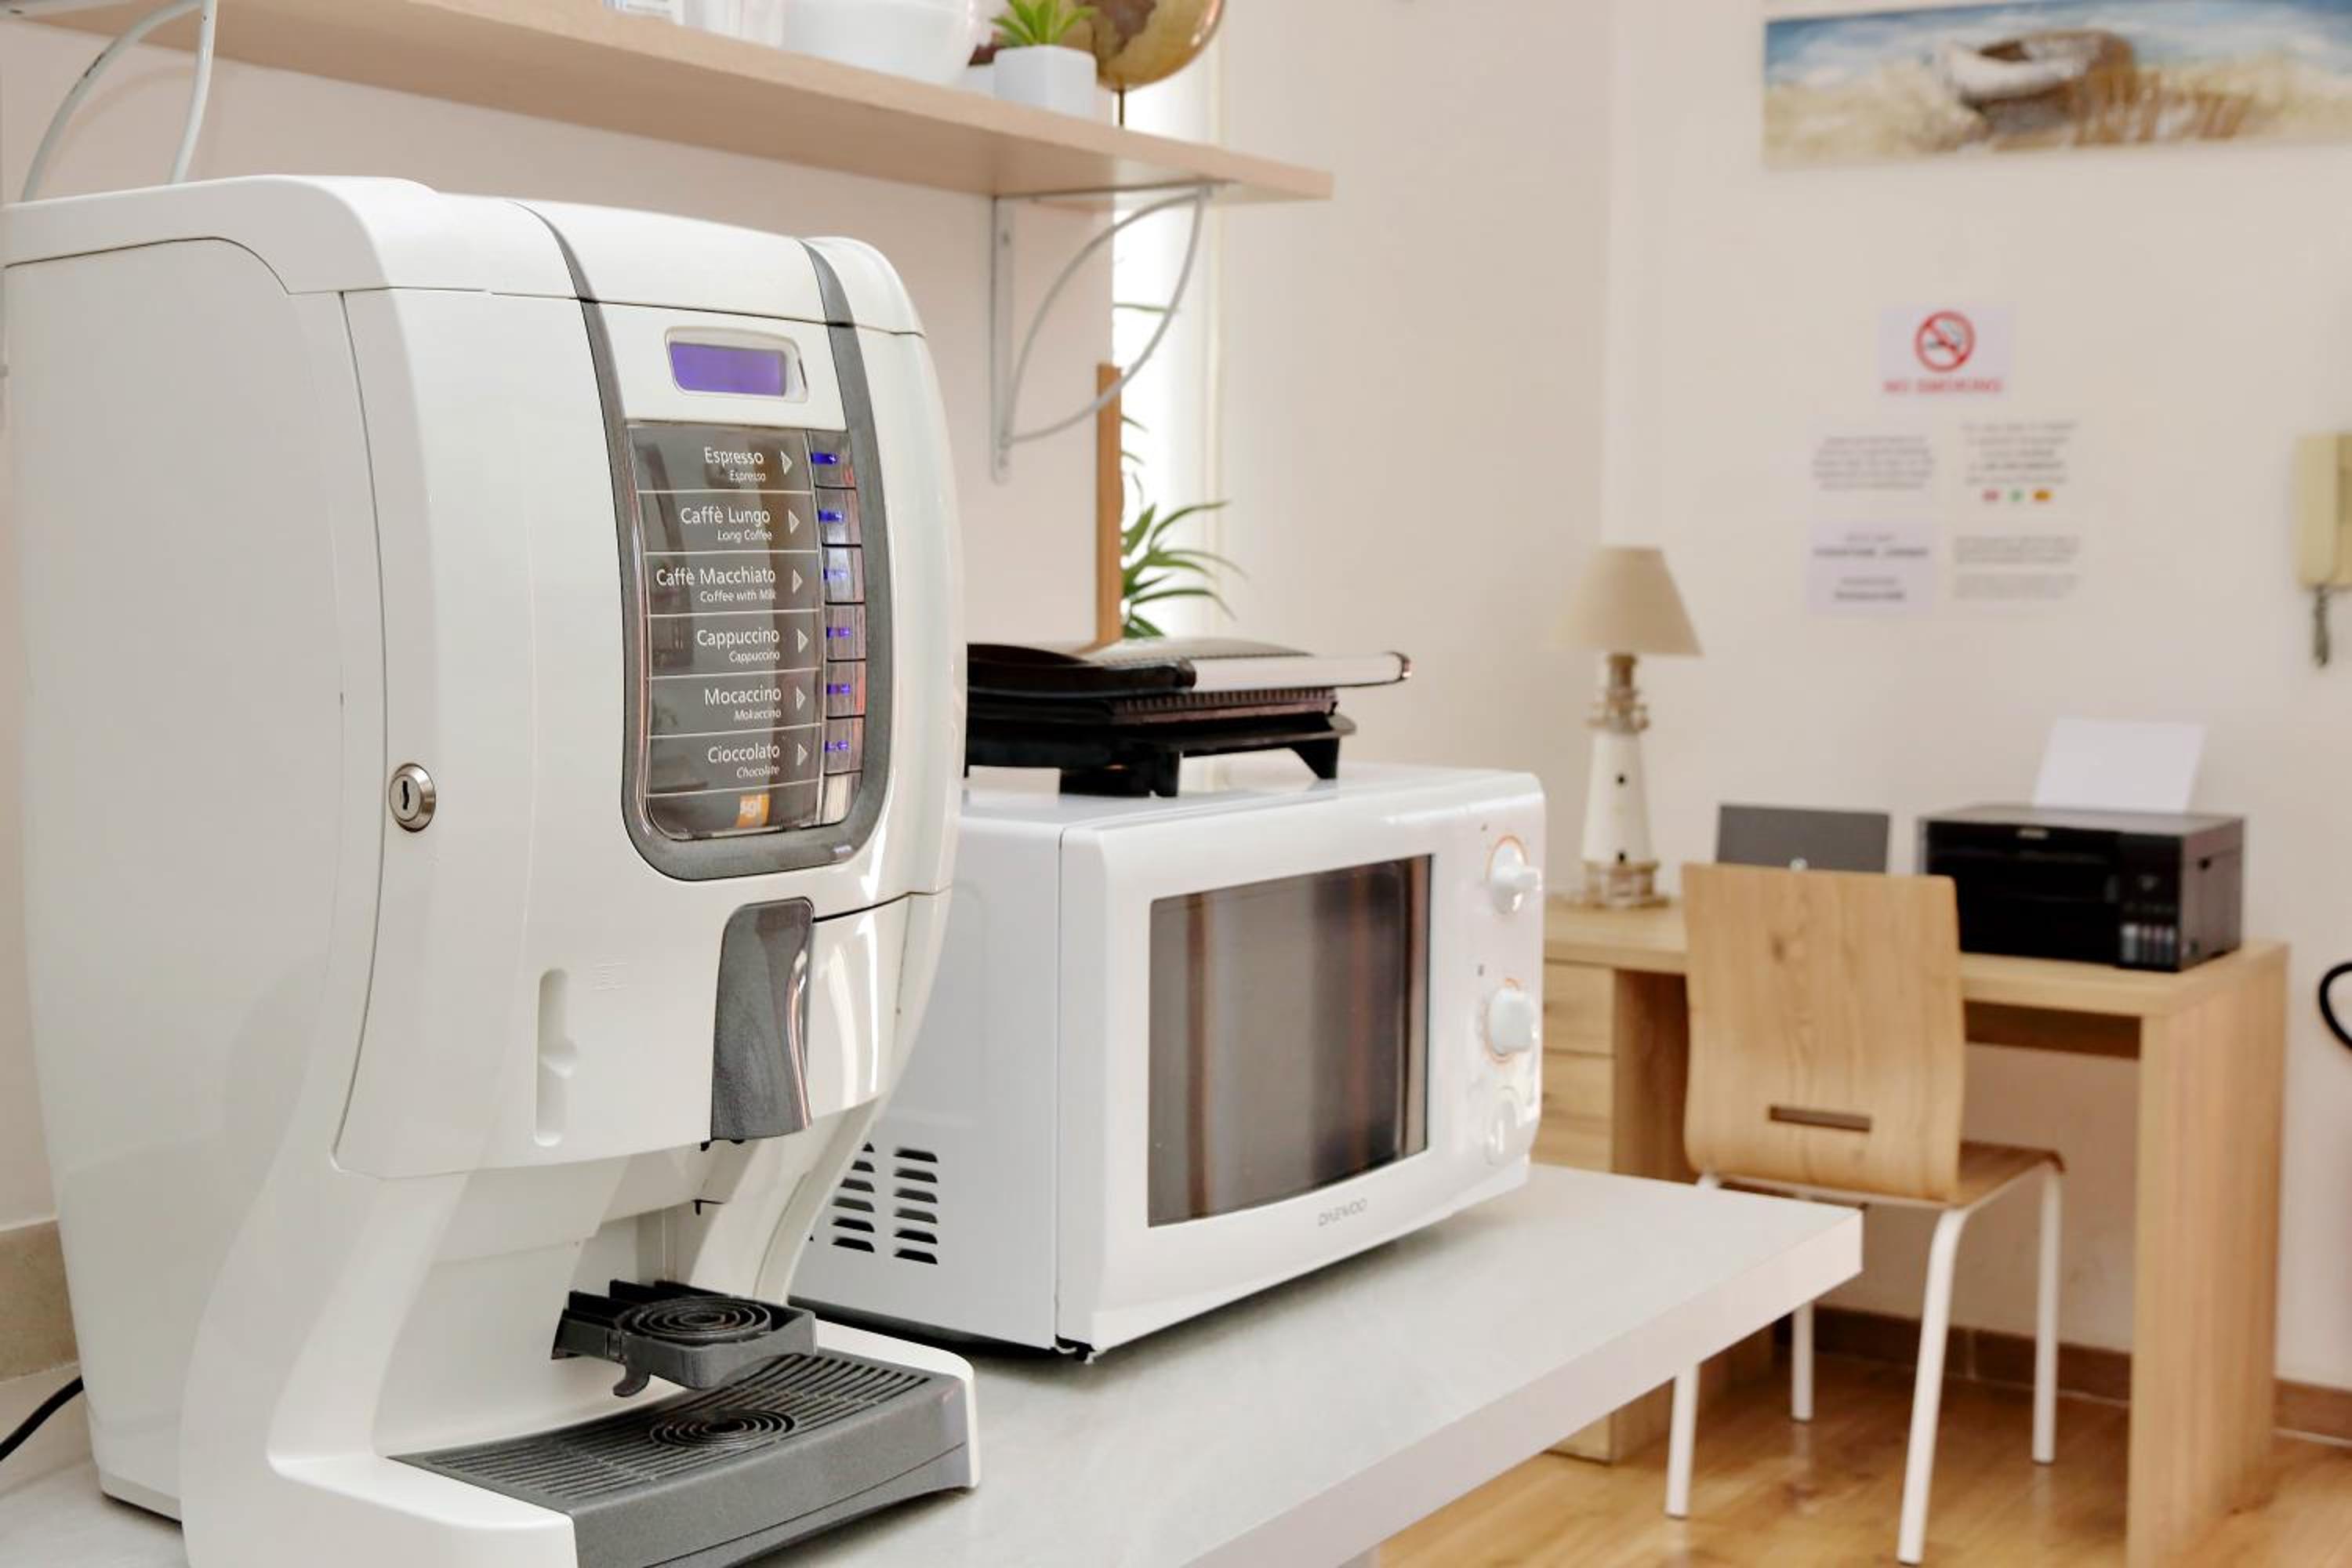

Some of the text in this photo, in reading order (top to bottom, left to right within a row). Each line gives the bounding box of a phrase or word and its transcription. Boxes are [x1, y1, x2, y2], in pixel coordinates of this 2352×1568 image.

[704, 446, 764, 467] Espresso
[730, 470, 766, 483] Espresso
[681, 506, 771, 528] Caffè Lungo
[717, 529, 772, 543] Long Coffee
[655, 566, 776, 586] Caffè Macchiato
[699, 588, 776, 603] Coffee with Milk
[697, 627, 780, 650] Cappuccino
[728, 649, 780, 665] Cappuccino
[705, 684, 782, 706] Mocaccino
[708, 742, 780, 764] Cioccolato
[736, 764, 780, 779] Chocolate
